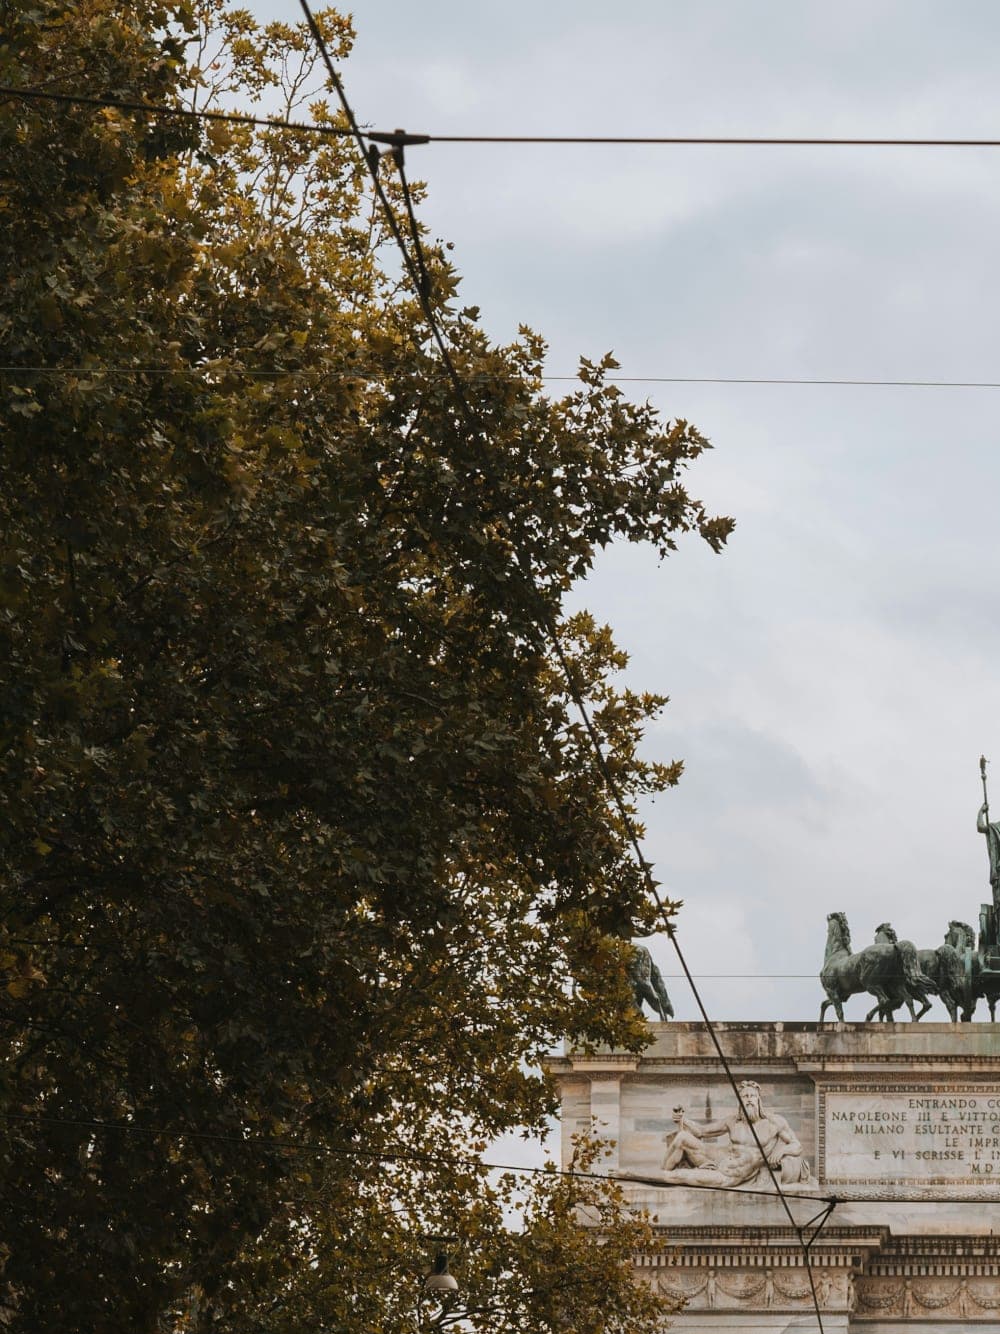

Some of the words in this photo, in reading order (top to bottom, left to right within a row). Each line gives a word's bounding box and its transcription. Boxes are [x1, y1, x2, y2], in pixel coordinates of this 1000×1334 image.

[909, 1099, 977, 1109] ENTRANDO
[832, 1112, 907, 1121] NAPOLEONE
[918, 1112, 930, 1121] III
[941, 1112, 947, 1121] E
[855, 1125, 904, 1134] MILANO
[915, 1125, 982, 1134] ESULTANTE
[946, 1138, 959, 1147] LE
[874, 1151, 880, 1160] E
[892, 1151, 905, 1160] VI
[915, 1151, 964, 1160] SCRISSE
